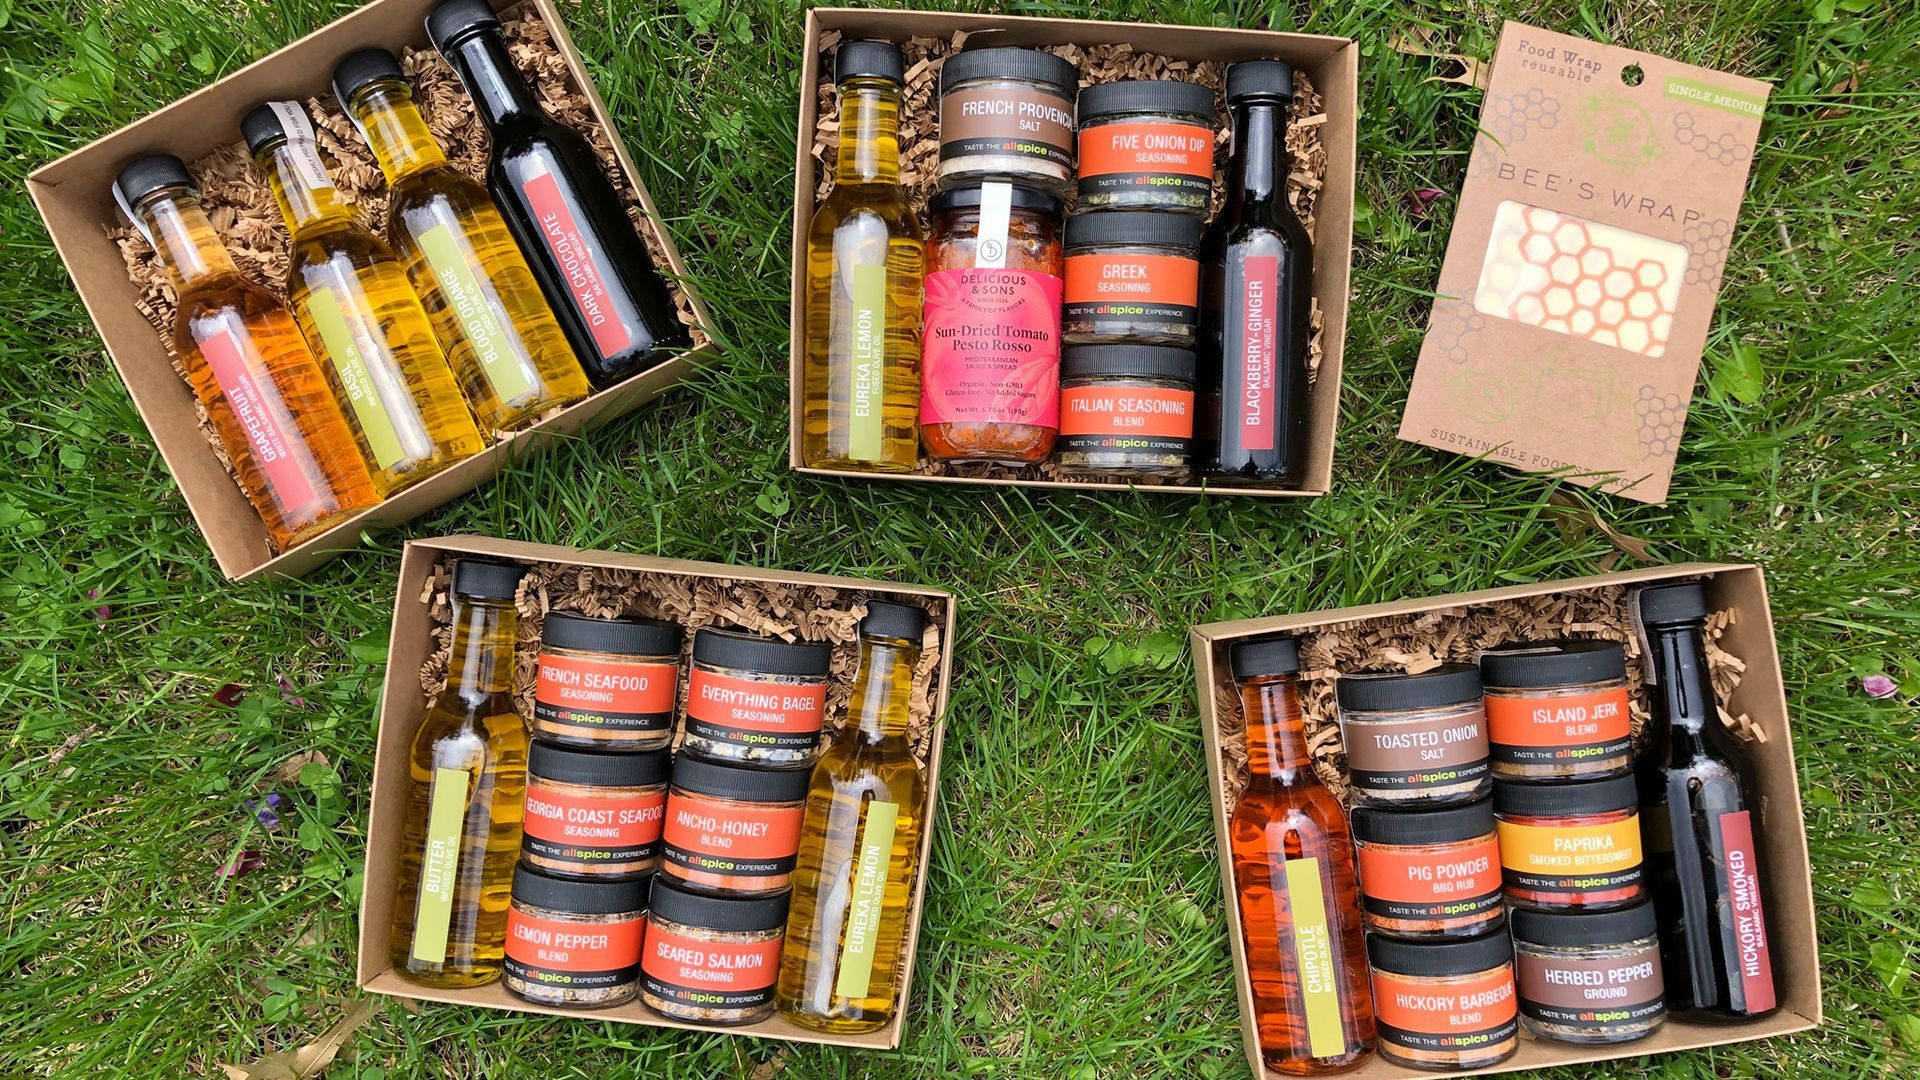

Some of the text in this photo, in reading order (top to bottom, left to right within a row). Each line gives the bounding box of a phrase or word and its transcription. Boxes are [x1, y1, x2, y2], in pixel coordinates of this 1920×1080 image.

[1518, 39, 1603, 73] Food Wrap
[1520, 57, 1593, 84] reusable
[1668, 81, 1764, 117] SINGLE MEDIUM
[962, 100, 1013, 117] FRENCH
[289, 115, 301, 129] FOR
[1019, 119, 1041, 132] SALT
[964, 141, 1048, 155] TASTE THE allspice
[1112, 134, 1206, 153] FIVE ONION DIP
[1135, 151, 1188, 165] SEASONING
[1098, 177, 1182, 188] TASTE THE allspice
[1497, 162, 1701, 226] BEE'S WRAP
[543, 211, 606, 327] DARK CHOCOLATE
[1102, 264, 1148, 279] GREEK
[961, 274, 1027, 286] DELICIOUS
[1097, 282, 1152, 294] SEASONING
[971, 285, 1015, 296] & SONS
[440, 265, 499, 364] BLOOD ORANGE
[1083, 305, 1184, 318] THE allspice EXPERIENCE
[935, 324, 1050, 342] Sun-Dried Tomato
[952, 339, 1032, 354] Pesto Rosso
[1246, 279, 1264, 427] BLACKBERRY-GINGER
[1262, 317, 1273, 389] BALSAMIC VINEGAR
[855, 309, 873, 418] EUREKA LEMON
[872, 333, 881, 396] FUSED OLIVE OIL
[964, 356, 1018, 364] MEDITERRANEAN
[993, 363, 1018, 371] SPREAD
[341, 361, 363, 401] BASIL
[959, 380, 985, 388] Organic
[995, 389, 1017, 397] Added
[1017, 391, 1036, 399] Sugars
[1071, 398, 1186, 416] ITALIAN SEASONING
[228, 386, 277, 463] GRAPEFRUIT
[1113, 416, 1145, 428] BLEND
[1086, 438, 1185, 451] THE allspice EXPERIENCE
[1430, 428, 1528, 462] SUSTAINABLE
[541, 665, 649, 692] FRENCH SEAFOOD
[560, 687, 614, 703] SEASONING
[702, 684, 817, 711] EVERYTHING BAGEL
[558, 708, 650, 727] allspice EXPERIENCE
[731, 707, 786, 723] SEASONING
[1533, 701, 1619, 724] ISLAND JERK
[696, 724, 776, 745] TASTE THE allspice
[1374, 723, 1478, 750] TOASTED ONION
[1565, 723, 1598, 737] BLEND
[1420, 747, 1445, 761] SALT
[1513, 745, 1605, 760] TASTE THE allspice
[1369, 770, 1456, 785] TASTE THE allspice
[527, 796, 664, 825] GEORGIA COAST SEAFOOD
[564, 823, 620, 838] SEASONING
[676, 810, 769, 837] ANCHO-HONEY
[700, 834, 733, 848] BLEND
[1554, 834, 1614, 852] PAPRIKA
[531, 841, 611, 860] TASTE THE allspice
[1528, 848, 1633, 866] SMOKED BITTERSWEET
[426, 839, 446, 894] BUTTER
[688, 853, 778, 871] allspice EXPERIENCE
[1408, 856, 1489, 881] PIG POWDER
[1432, 878, 1475, 894] BBQ RUB
[1518, 876, 1609, 890] TASTE THE allspice
[850, 845, 881, 953] EUREKA LEMON
[868, 871, 886, 932] FUSED OLIVE OIL
[1388, 901, 1477, 916] TASTE THE allspice
[1729, 850, 1760, 977] HICKORY SMOKED
[514, 922, 609, 950] LEMON PEPPER
[537, 948, 569, 963] BLEND
[657, 941, 763, 968] SEARED SALMON
[1300, 925, 1322, 994] CHIPOTLE
[526, 969, 617, 984] allspice EXPERIENCE
[679, 965, 734, 983] SEASONING
[1545, 961, 1653, 986] HERBED PEPPER
[647, 980, 766, 1004] TASTE THE allspice EXPERIENCE
[1396, 980, 1513, 1011] HICKORY BARBEQUE
[1583, 986, 1628, 1000] GROUND
[1450, 1012, 1482, 1025] BLEND
[1539, 1008, 1630, 1023] TASTE THE allspice
[1400, 1033, 1489, 1047] TASTE THE allspice
